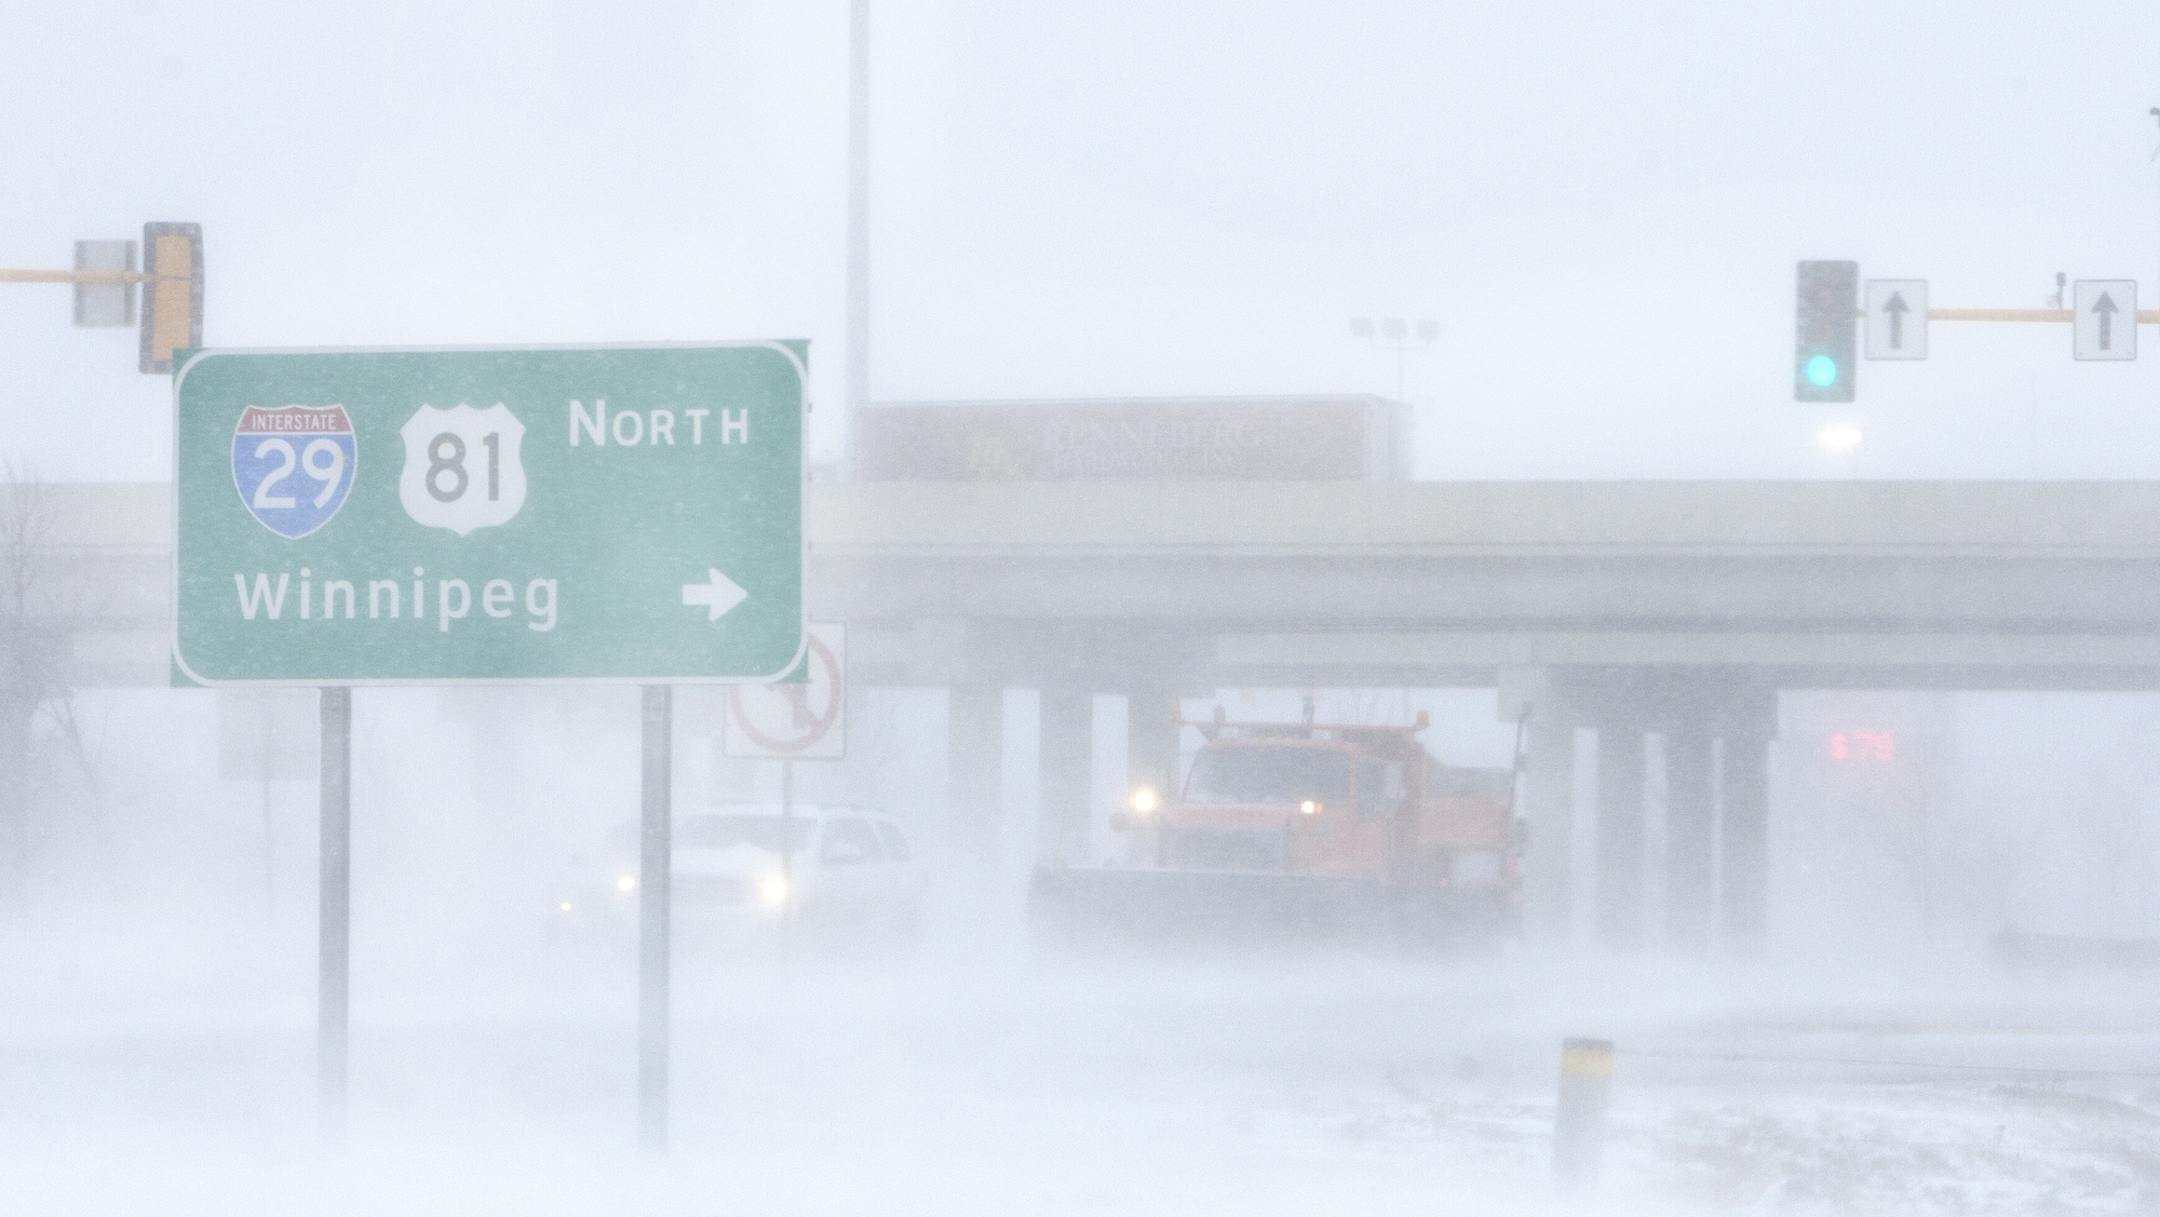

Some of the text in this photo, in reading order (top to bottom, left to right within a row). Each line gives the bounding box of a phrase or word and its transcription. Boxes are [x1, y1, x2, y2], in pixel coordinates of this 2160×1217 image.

[252, 413, 337, 431] INTERSTATE
[569, 399, 750, 447] NORTH
[253, 438, 344, 509] 29
[425, 431, 500, 503] 81
[235, 566, 559, 632] Winnipeg
